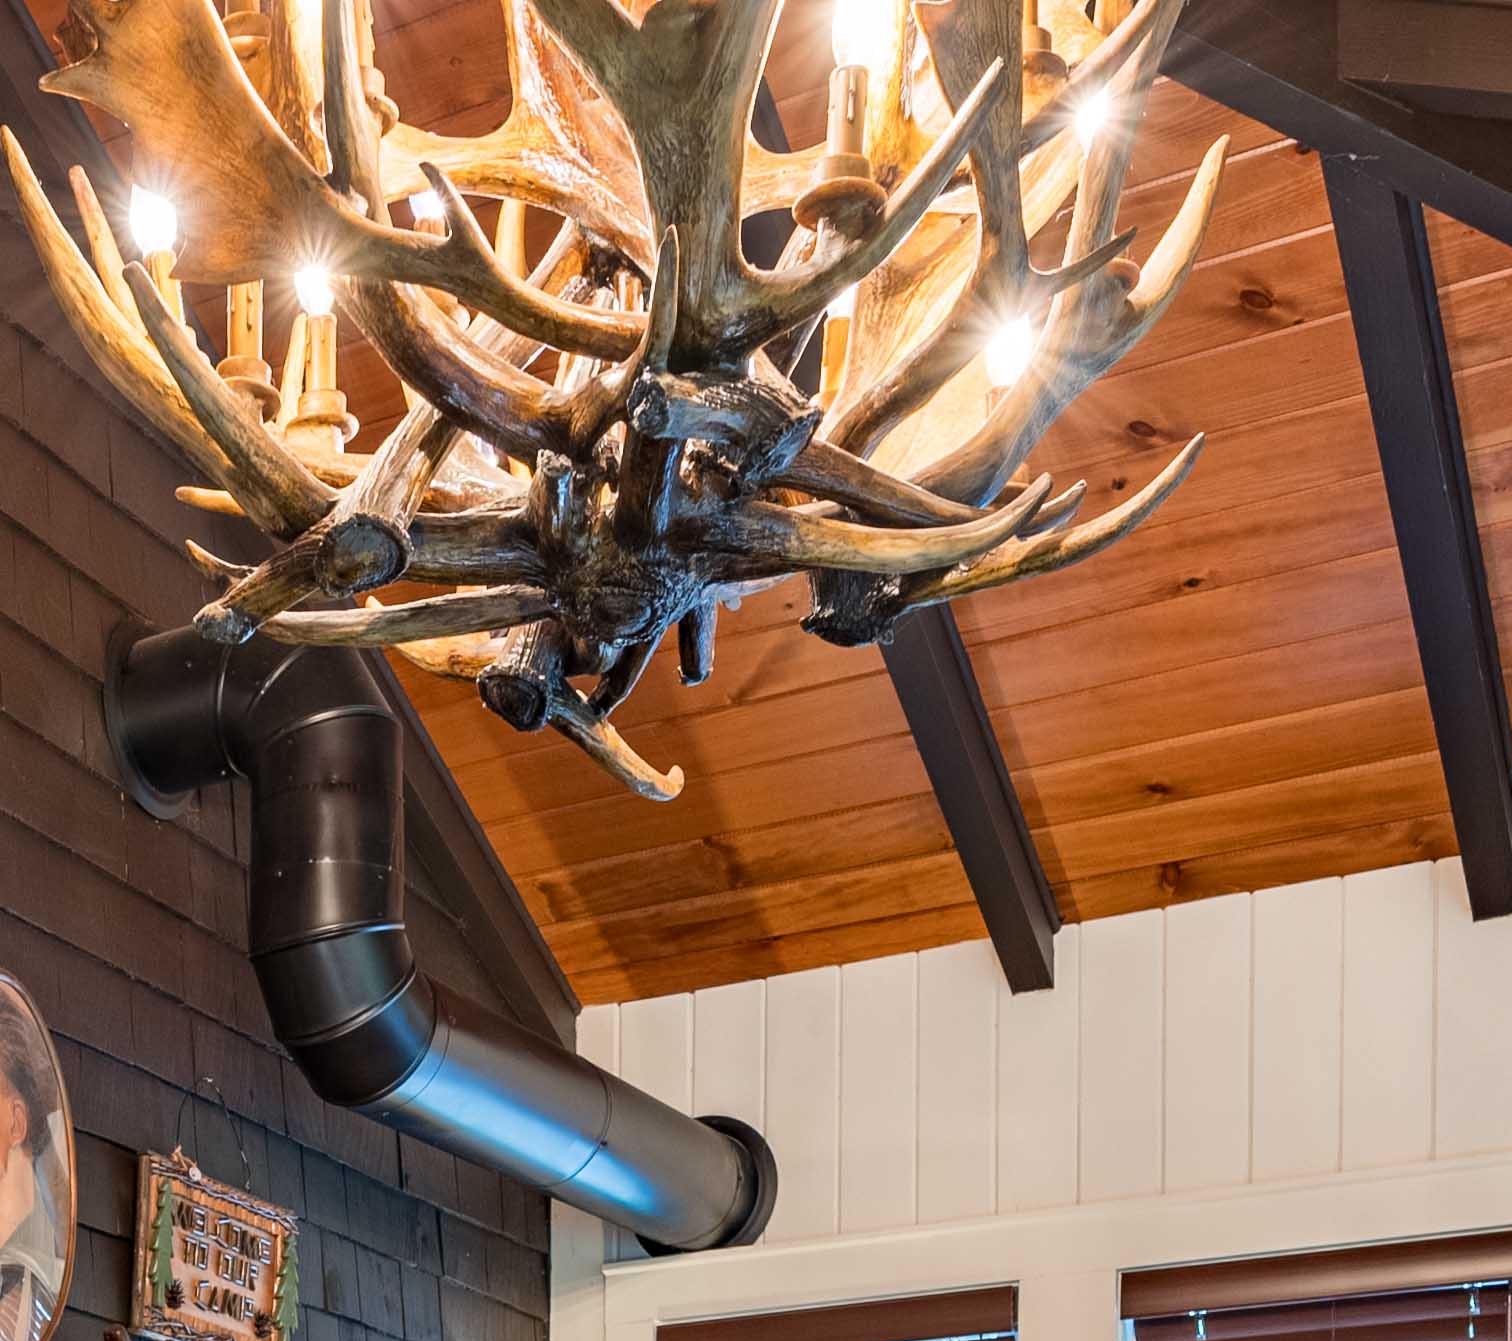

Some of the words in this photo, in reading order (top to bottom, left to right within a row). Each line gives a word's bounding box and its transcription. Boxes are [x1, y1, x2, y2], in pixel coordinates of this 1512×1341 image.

[171, 1199, 272, 1265] WELCOME
[183, 1236, 209, 1271] TO
[217, 1249, 259, 1291] OUR
[193, 1280, 256, 1321] CAMP
